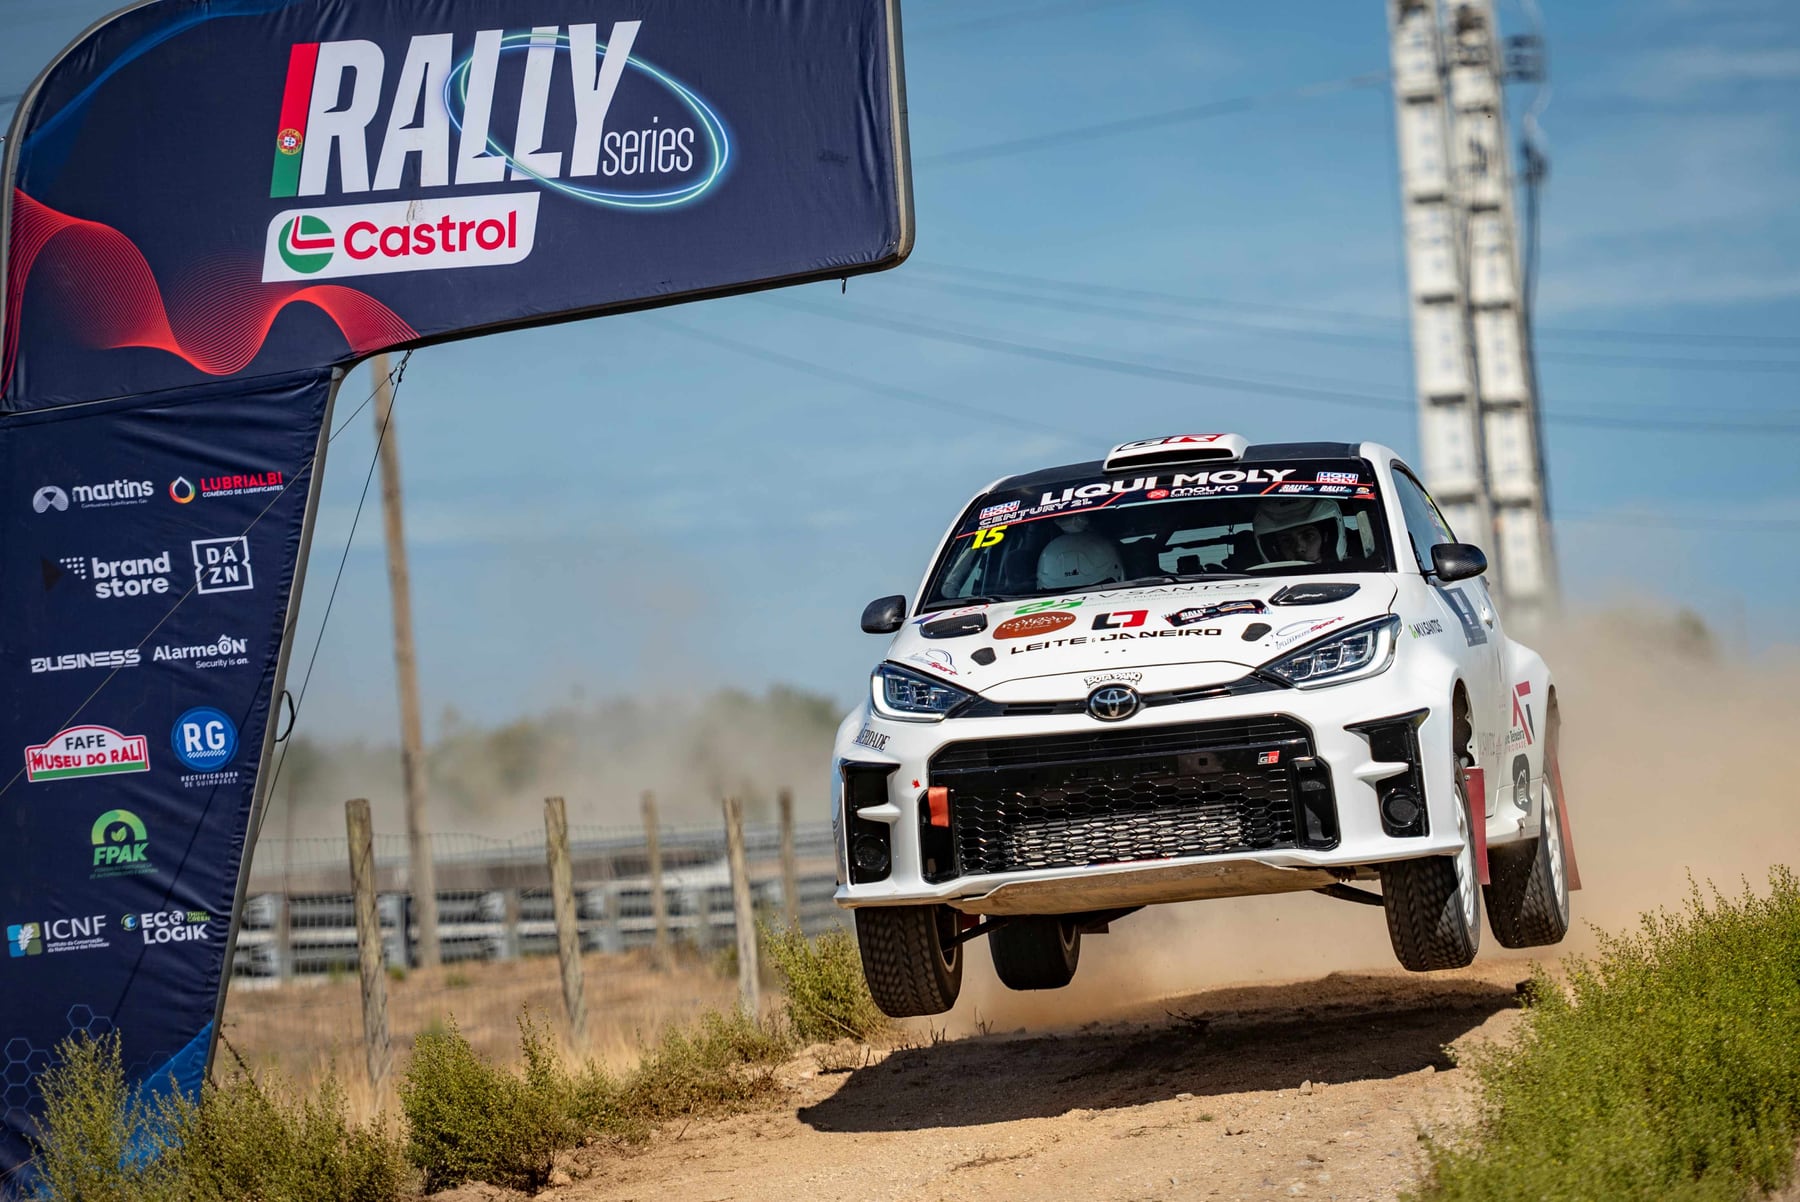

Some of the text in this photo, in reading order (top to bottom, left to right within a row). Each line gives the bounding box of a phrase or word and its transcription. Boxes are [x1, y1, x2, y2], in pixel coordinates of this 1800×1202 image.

[298, 19, 642, 197] RALLY
[602, 117, 694, 177] series
[343, 210, 518, 261] Castrol
[72, 479, 154, 502] martins
[201, 472, 283, 491] LUBRIALBI
[1040, 469, 1297, 506] LIQUI MOLY
[1170, 485, 1239, 496] moura
[979, 501, 1070, 526] CENTURY
[971, 525, 1009, 550] 15
[92, 551, 171, 579] brand
[95, 576, 169, 599] store
[1010, 636, 1088, 655] LEITE
[1100, 628, 1222, 642] JANEIRO
[195, 657, 227, 669] Security
[228, 658, 235, 666] is
[65, 734, 107, 750] FAFE
[183, 720, 226, 753] RG
[31, 740, 143, 771] MUSEU DO RALI
[1258, 753, 1279, 764] GR
[93, 843, 149, 866] FPAK
[43, 914, 107, 941] ICNF
[141, 910, 184, 929] ECO
[142, 923, 209, 945] LOGIK
